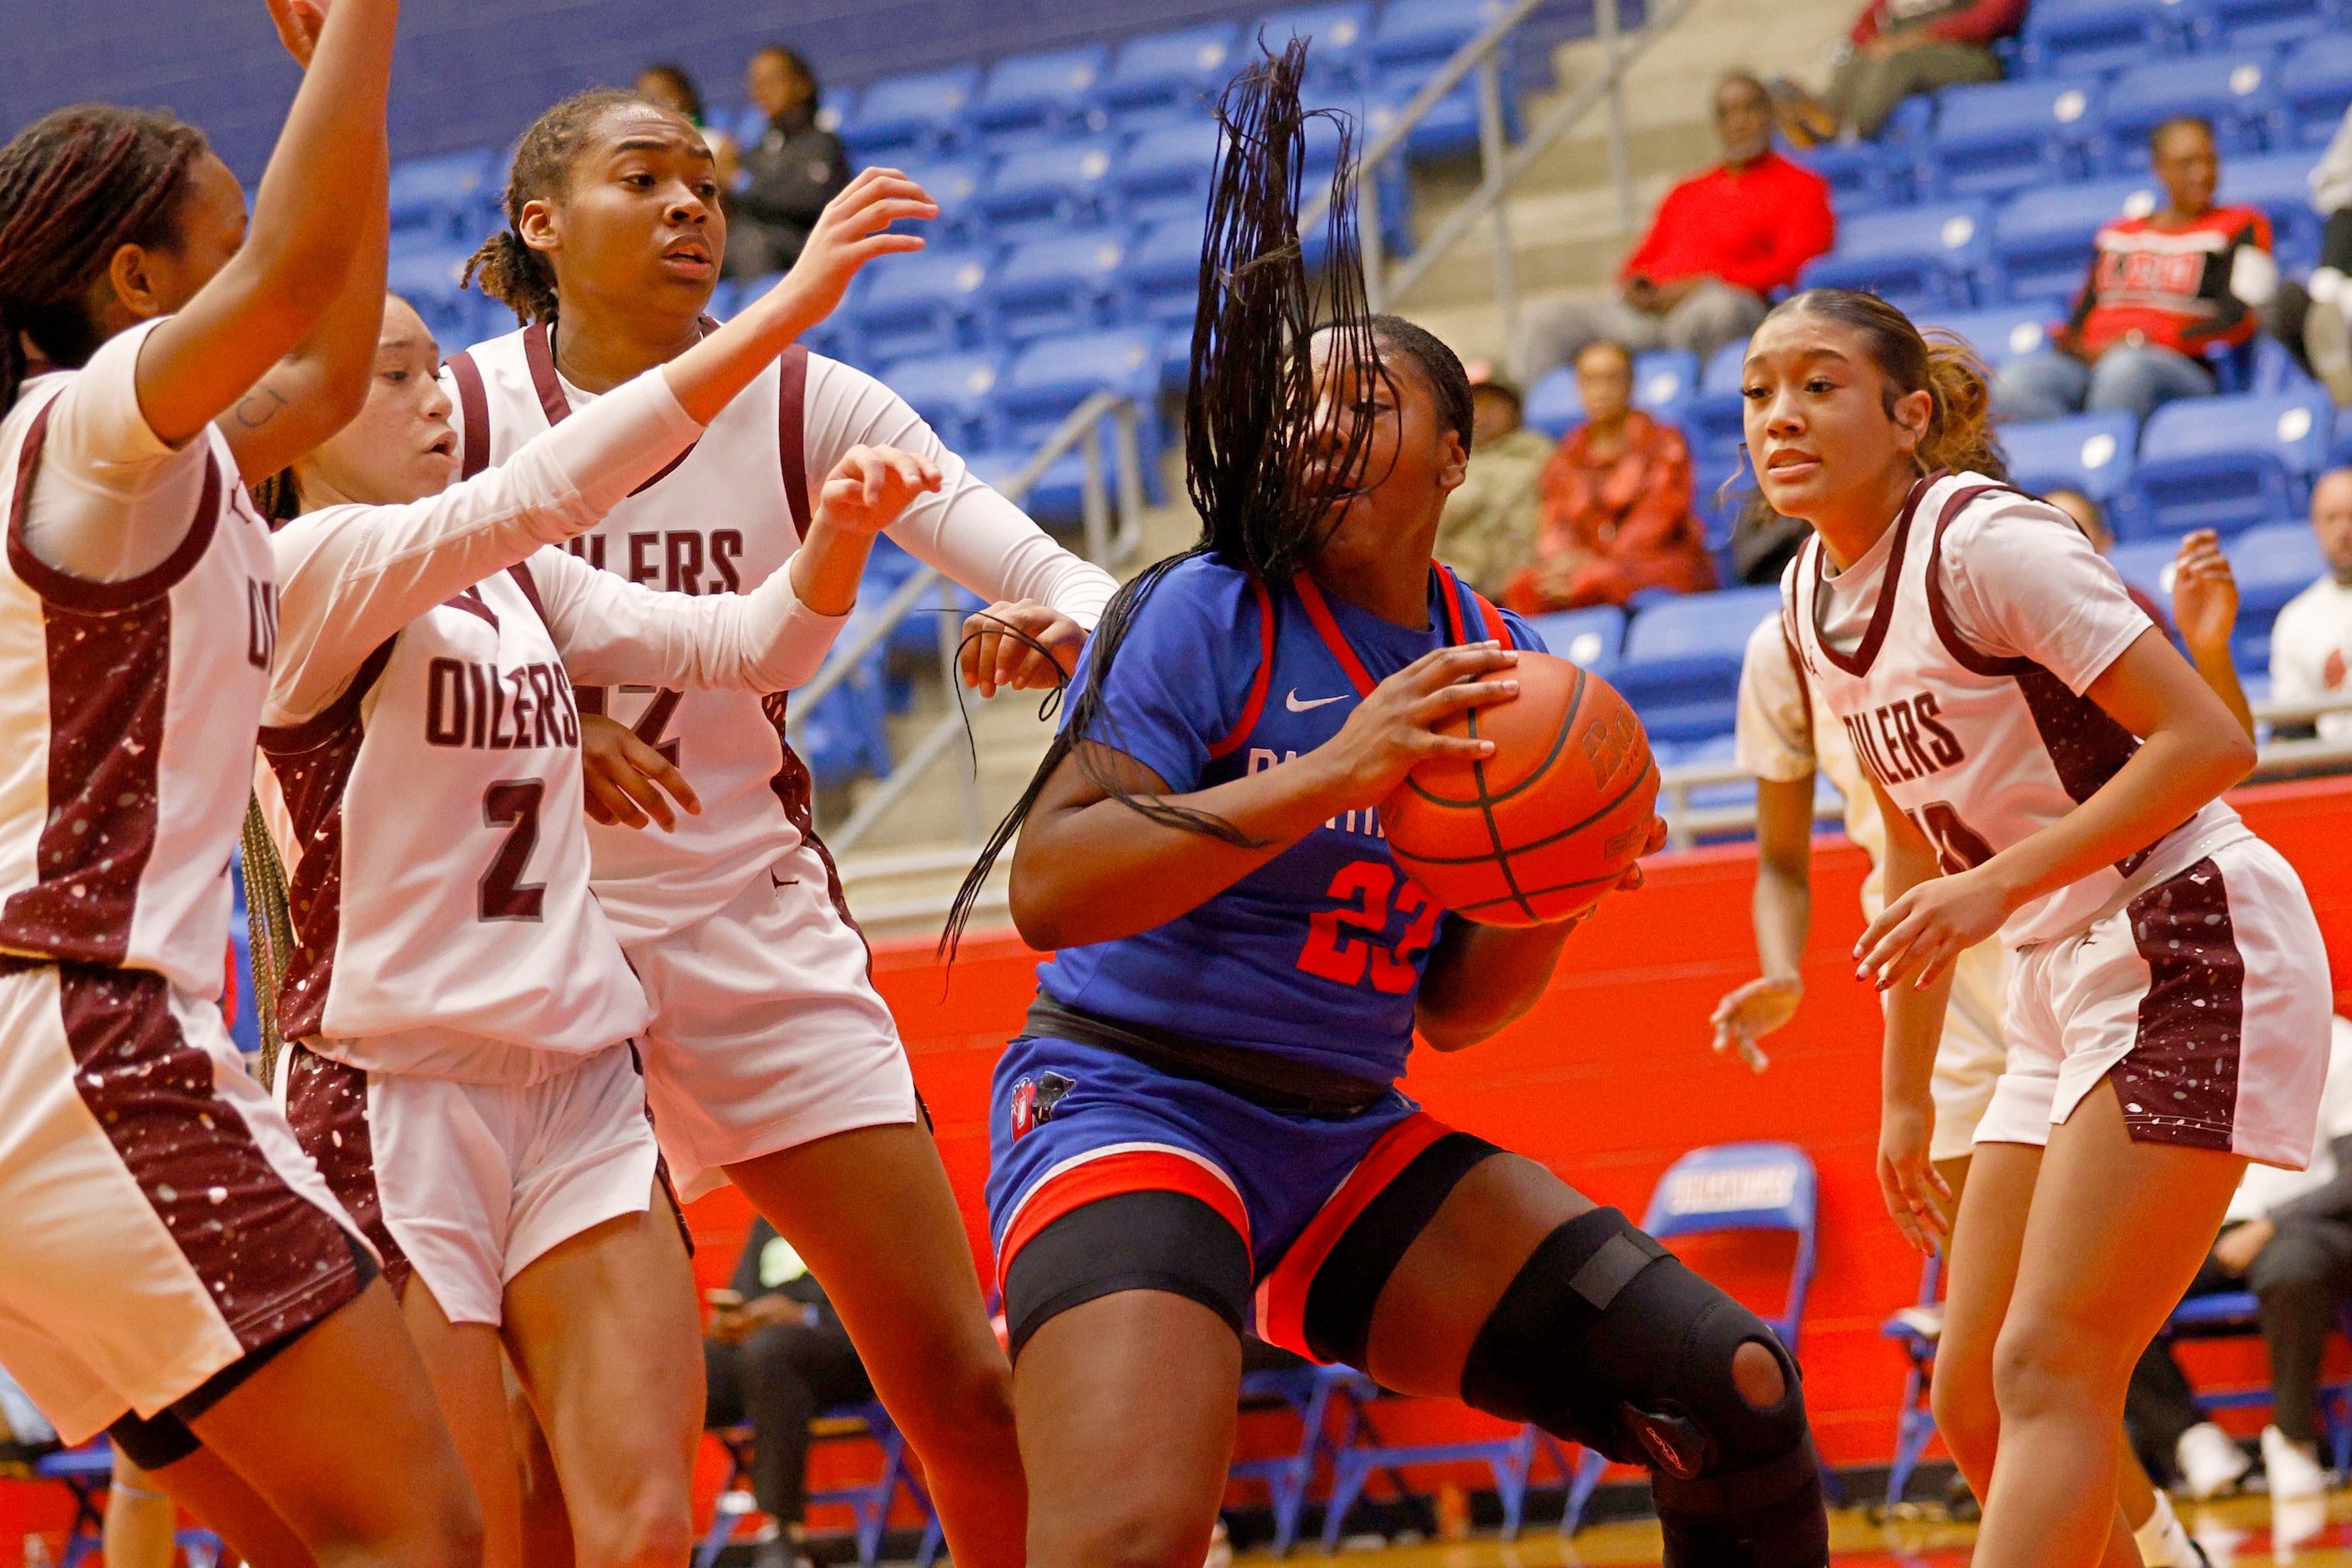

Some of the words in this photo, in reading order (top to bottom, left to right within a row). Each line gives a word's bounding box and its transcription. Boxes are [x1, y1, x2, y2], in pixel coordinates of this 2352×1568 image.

[425, 656, 579, 750] OILERS
[478, 777, 548, 923] 2
[1296, 860, 1449, 995] 23
